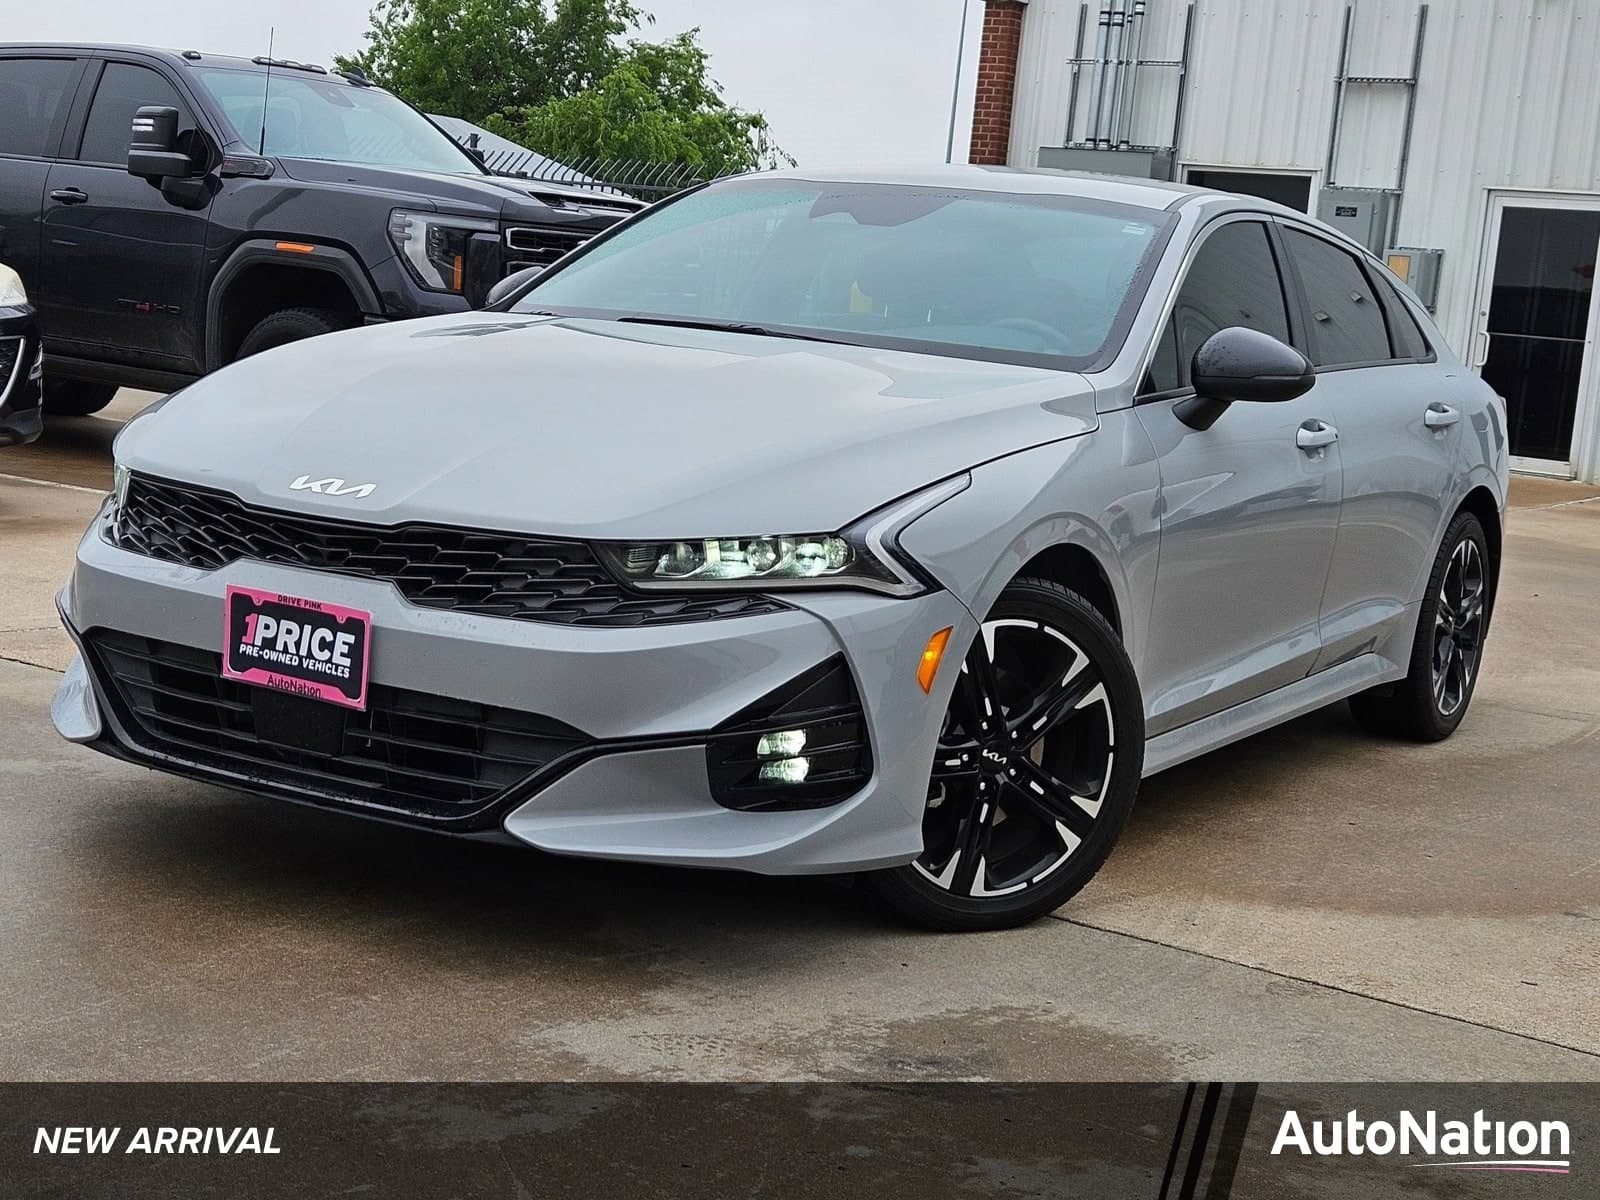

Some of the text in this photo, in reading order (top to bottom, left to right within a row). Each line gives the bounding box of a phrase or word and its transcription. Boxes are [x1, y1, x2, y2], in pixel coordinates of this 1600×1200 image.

[288, 474, 377, 499] KIA
[277, 594, 322, 610] DRIVE PINK
[239, 643, 350, 679] PRE-OWNED VEHICLES
[267, 674, 322, 698] AutoNation
